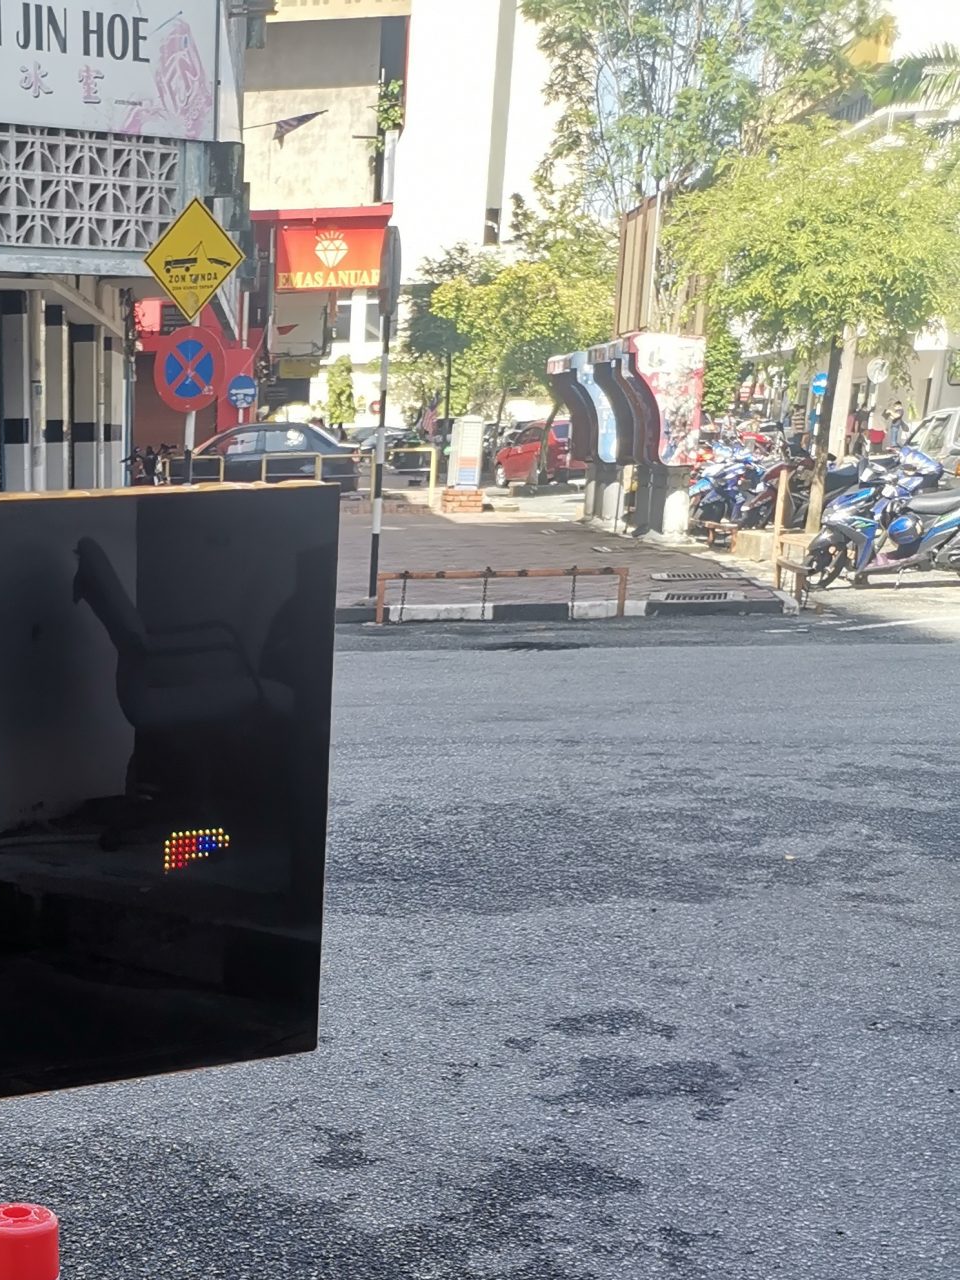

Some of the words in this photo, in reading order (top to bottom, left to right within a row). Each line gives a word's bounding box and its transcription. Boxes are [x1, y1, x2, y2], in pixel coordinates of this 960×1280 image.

[16, 1, 68, 54] JIN
[83, 10, 150, 63] HOE
[168, 274, 186, 284] ZON
[277, 271, 324, 289] EMAS
